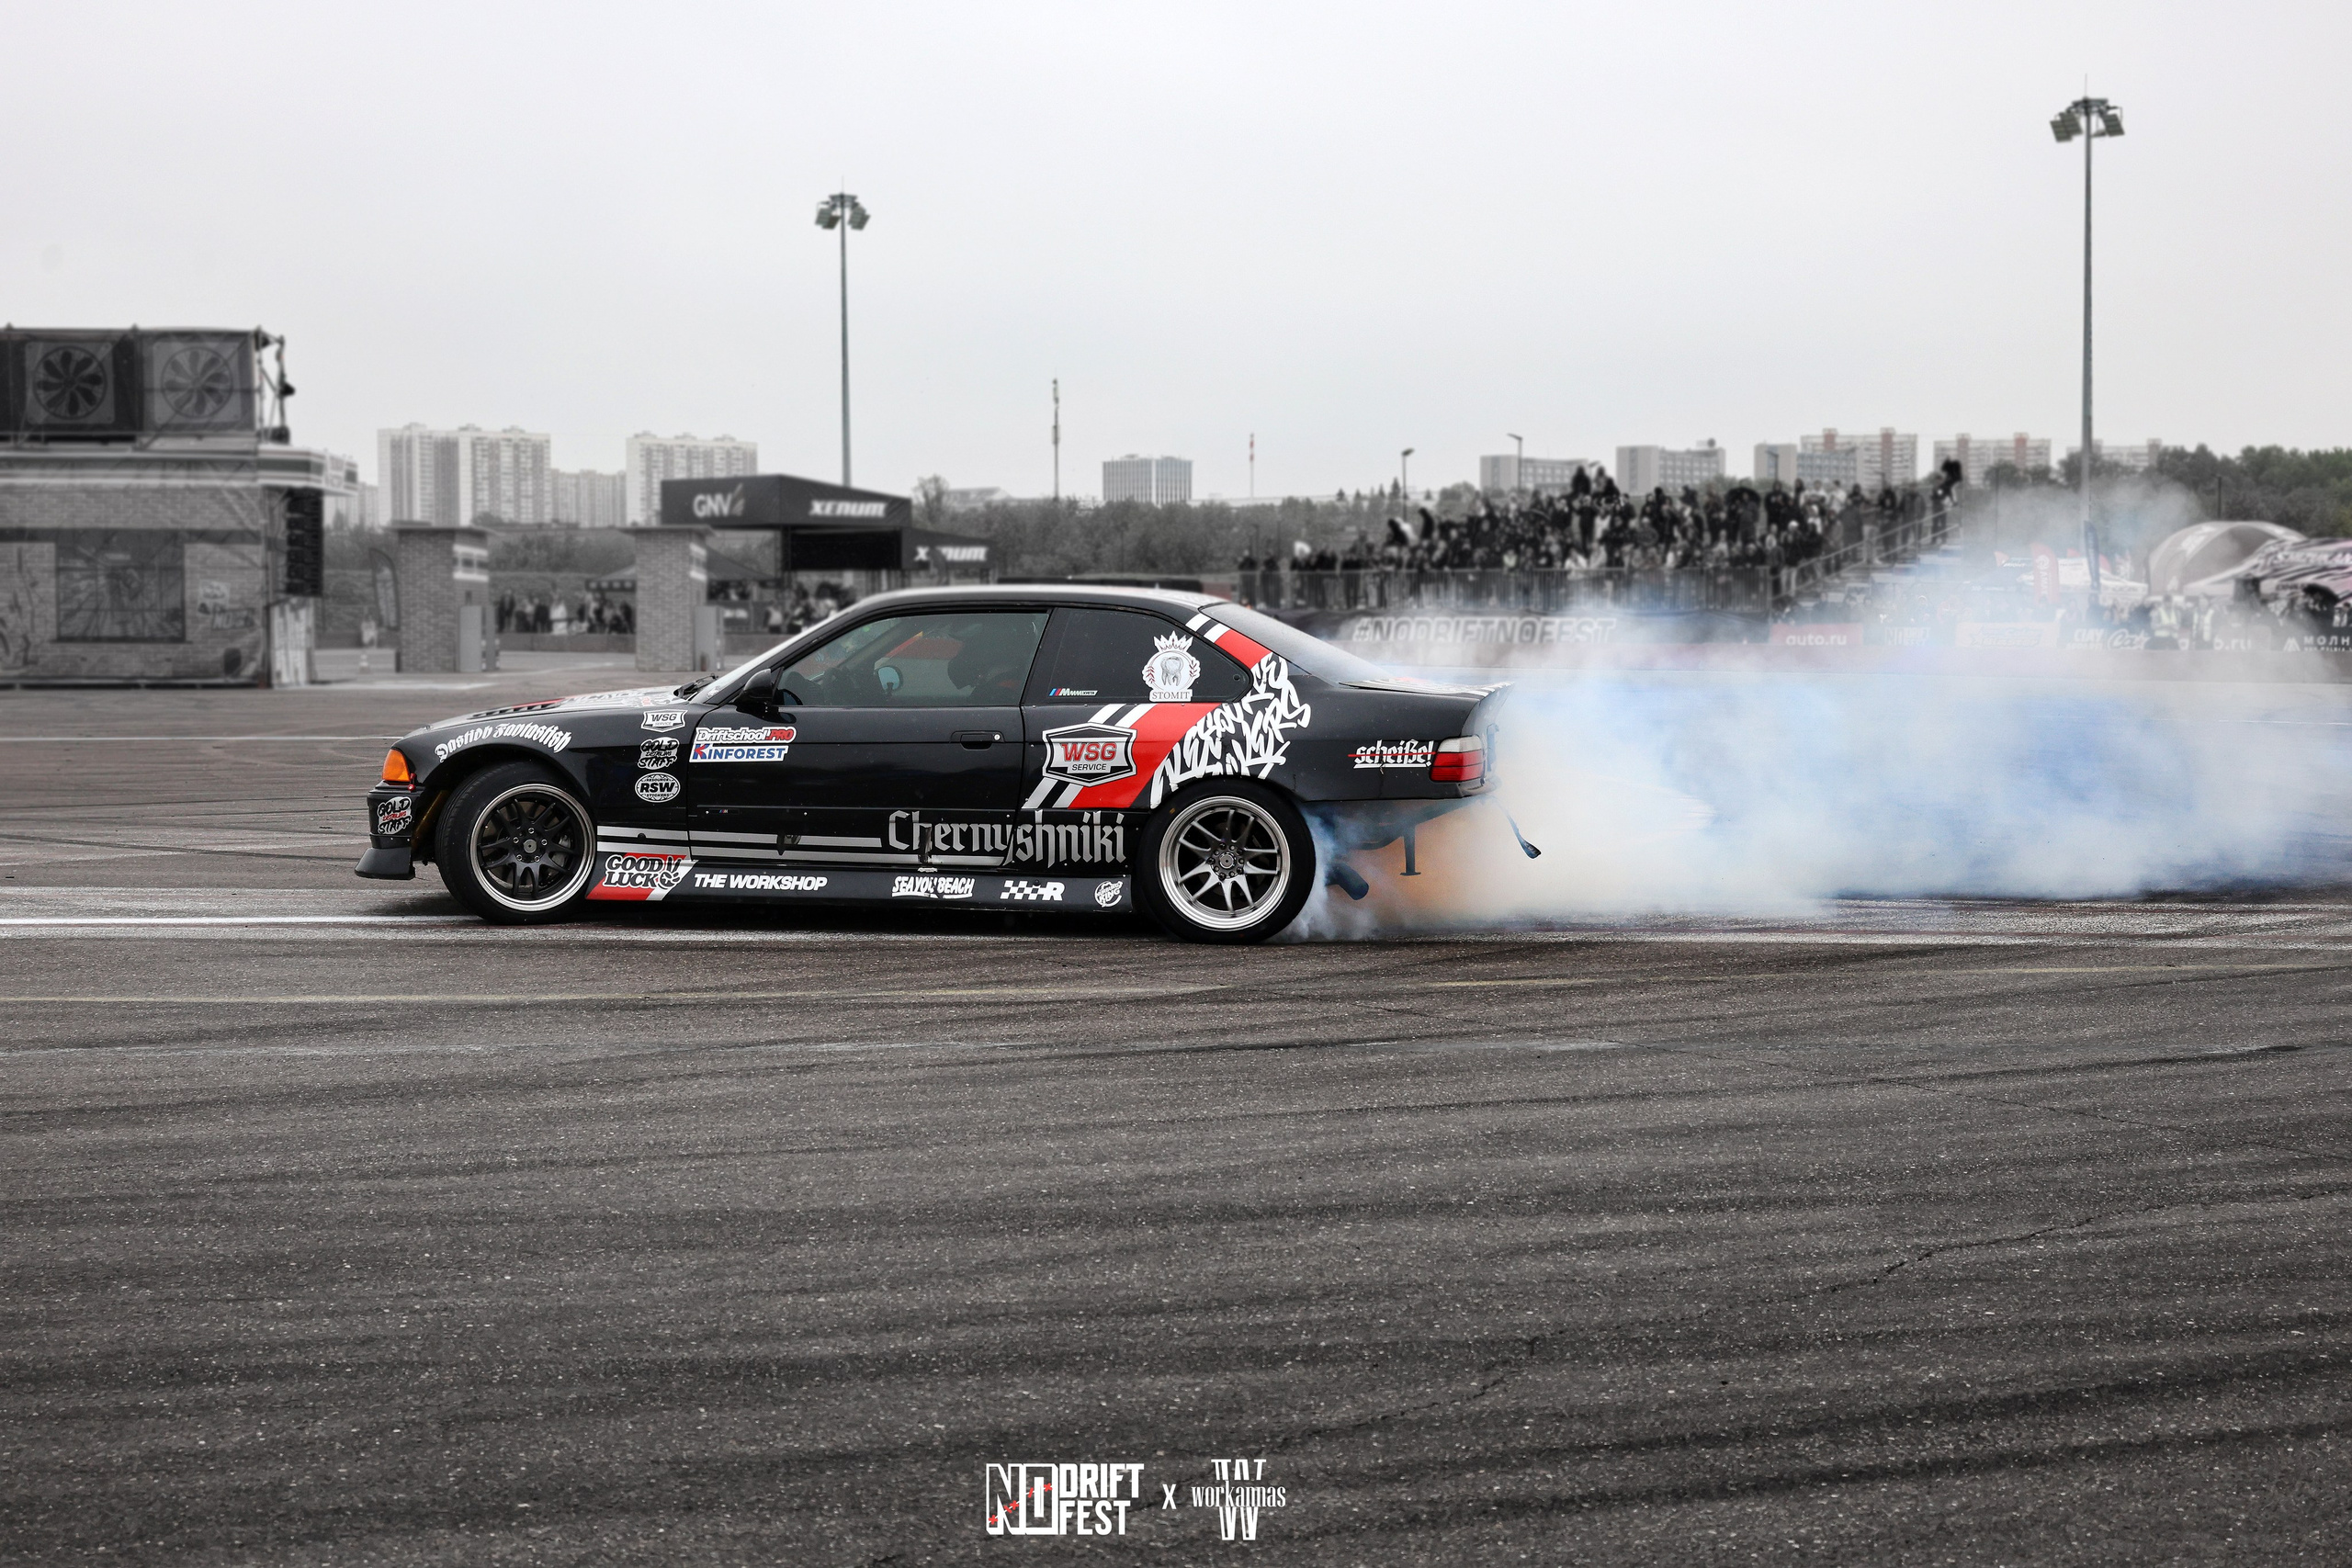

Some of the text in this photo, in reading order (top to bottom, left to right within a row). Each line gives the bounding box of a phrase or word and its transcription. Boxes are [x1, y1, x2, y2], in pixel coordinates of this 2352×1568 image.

[693, 493, 732, 517] GNV
[1785, 632, 1848, 647] auto.ru
[1152, 691, 1191, 700] STOMIT
[650, 713, 678, 722] WSG
[692, 743, 786, 760] KINFOREST
[1061, 742, 1118, 762] WSG
[1071, 763, 1107, 772] SERVICE
[639, 782, 676, 794] RSW
[605, 854, 663, 872] GOOD
[604, 872, 658, 888] LUCK
[695, 874, 828, 891] THE WORKSHOP
